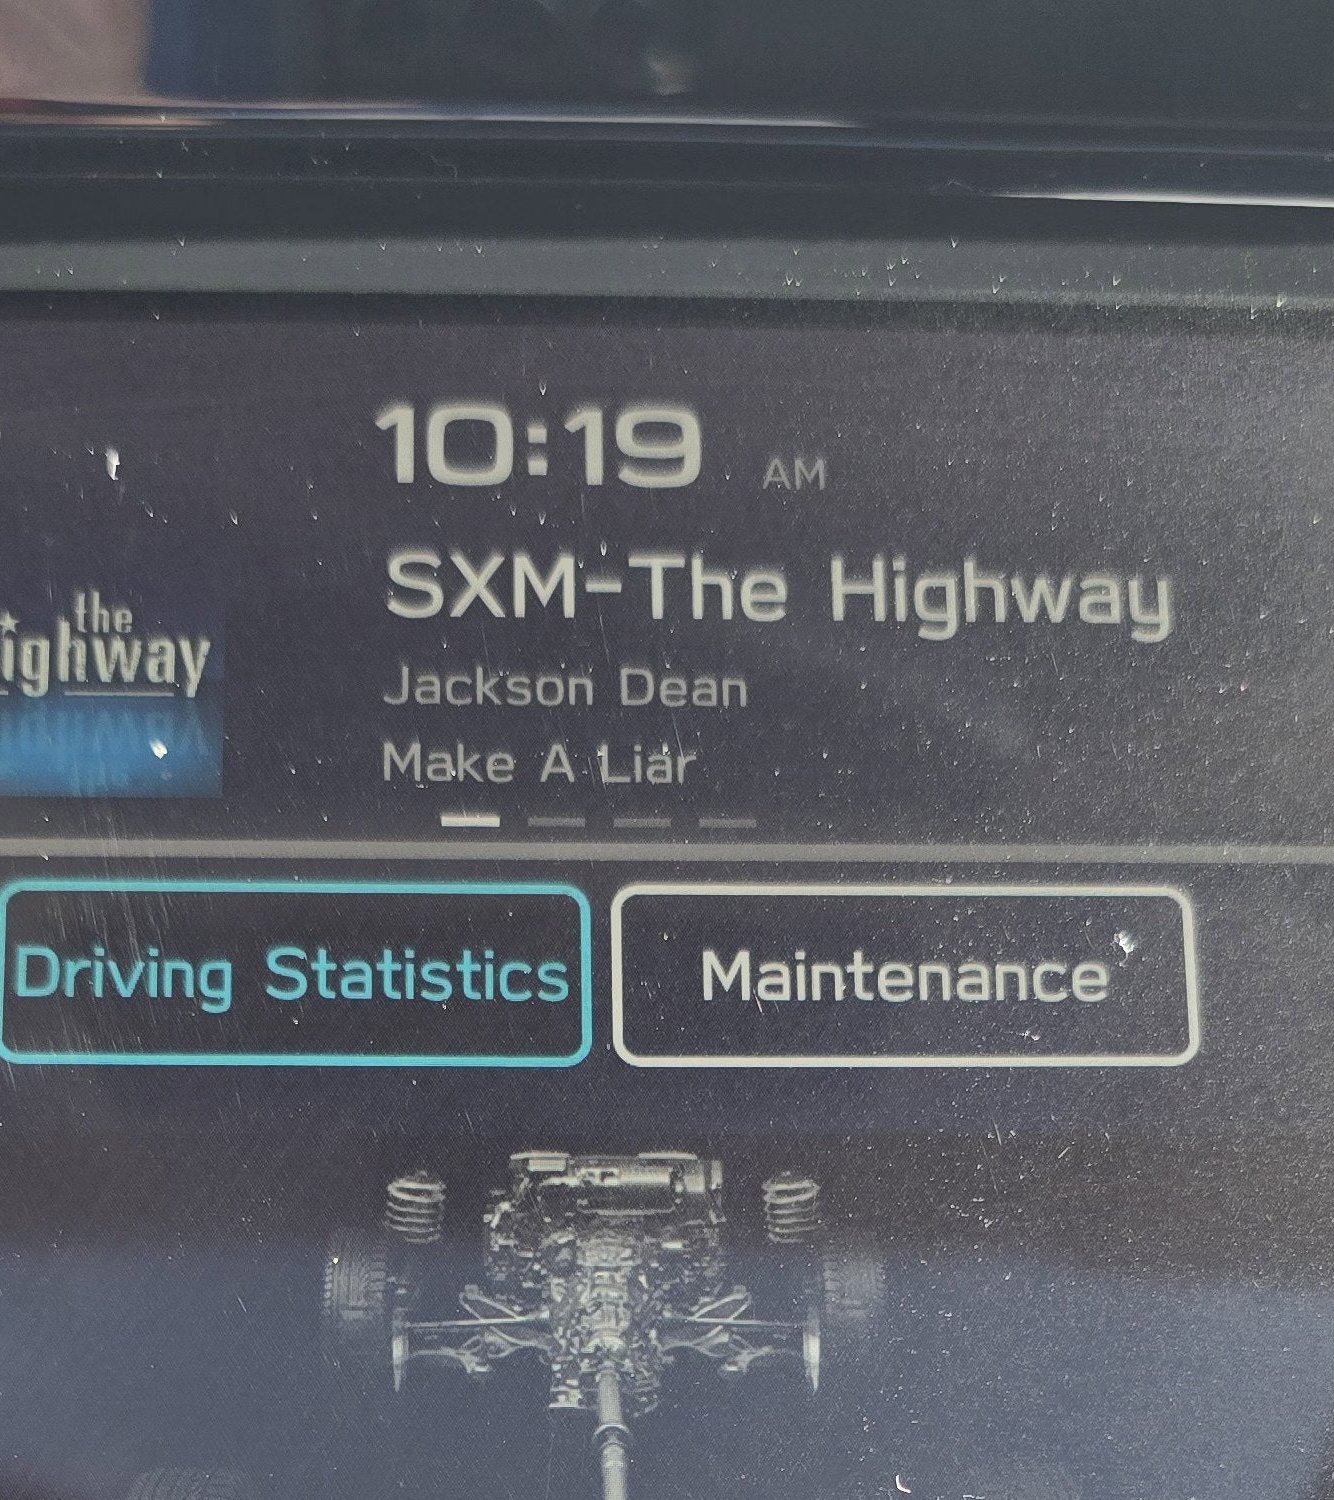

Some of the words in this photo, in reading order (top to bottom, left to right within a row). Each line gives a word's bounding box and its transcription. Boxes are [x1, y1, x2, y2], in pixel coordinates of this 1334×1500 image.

[374, 404, 702, 489] 10:19
[762, 458, 827, 491] AM
[74, 590, 133, 634] the
[385, 550, 788, 623] SXM-The
[831, 557, 1174, 643] Highway
[382, 666, 594, 708] Jackson
[621, 668, 749, 708] Dean
[382, 742, 515, 785] Make
[540, 743, 576, 784] A
[601, 743, 697, 786] Liar
[15, 945, 234, 1013] Driving
[266, 946, 571, 1004] Statistics
[701, 949, 1111, 1005] Maintenance
